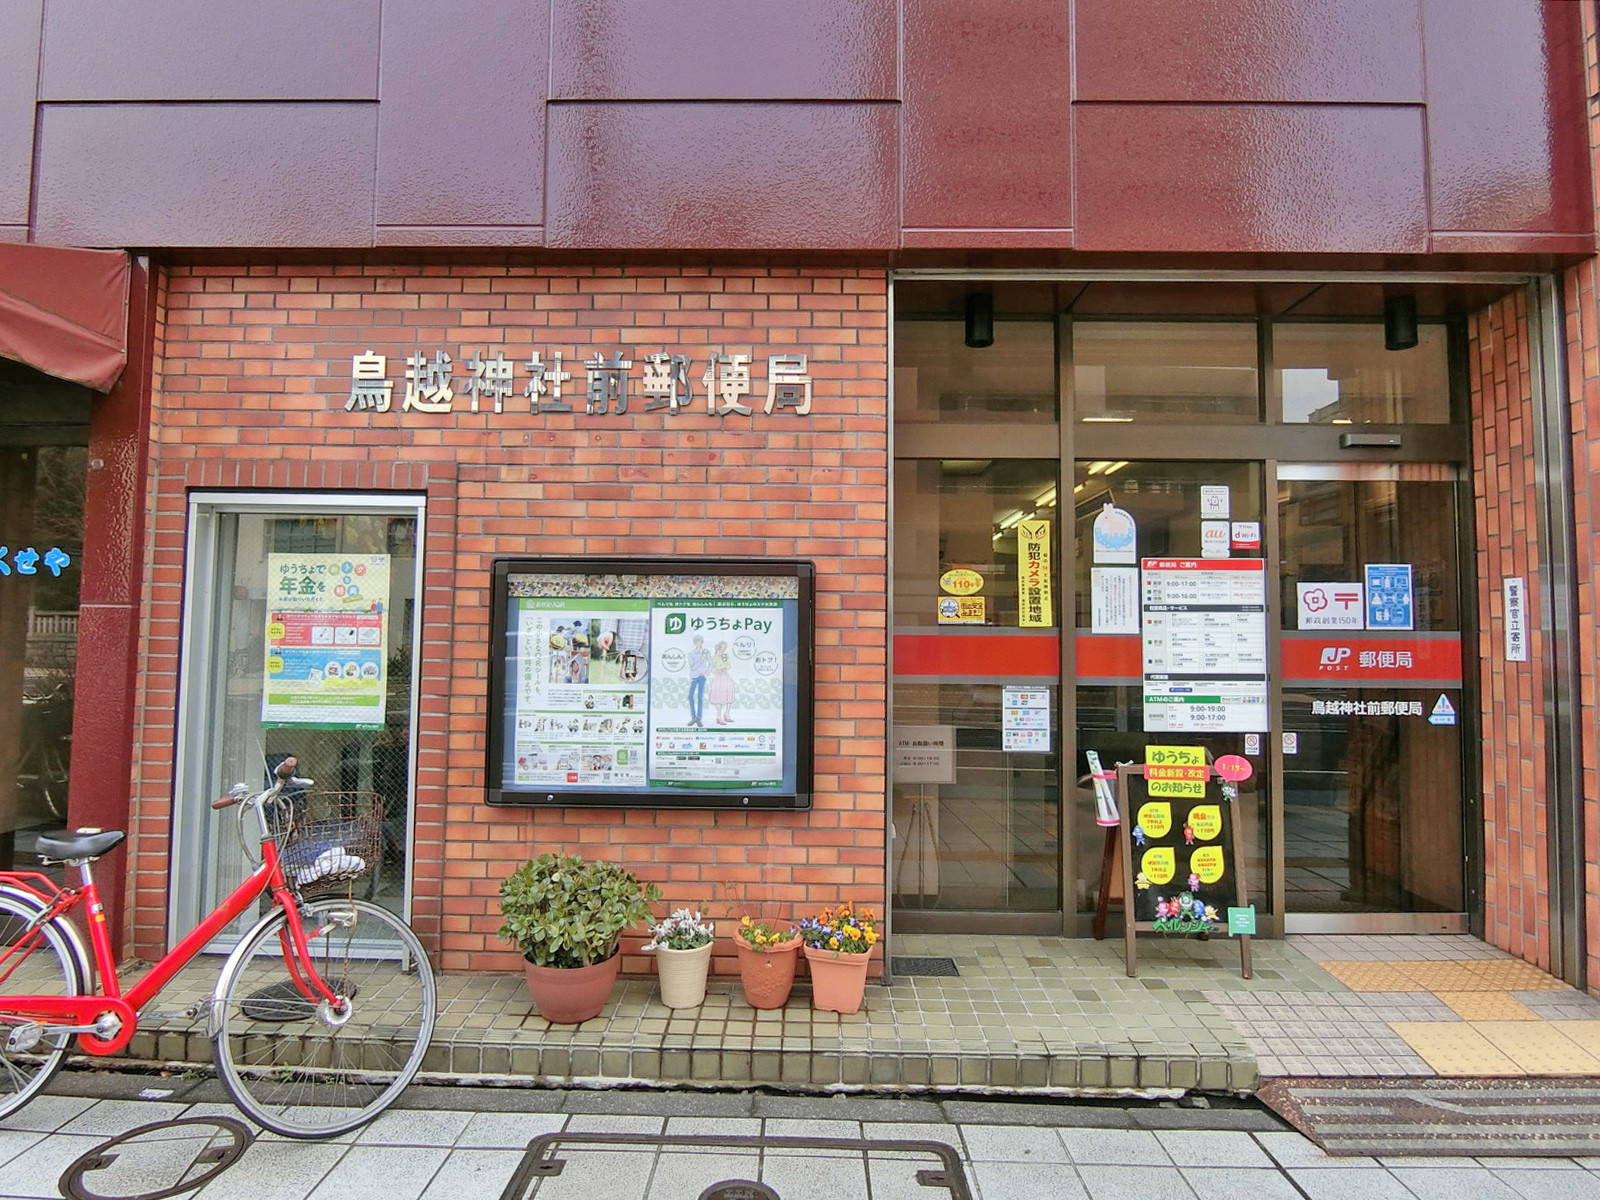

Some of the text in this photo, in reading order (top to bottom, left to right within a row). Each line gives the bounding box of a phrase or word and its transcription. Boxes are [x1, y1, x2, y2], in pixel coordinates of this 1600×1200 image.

[344, 350, 813, 416] 鳥越神社前郵便局
[280, 563, 327, 575] ゆうちょで
[279, 576, 326, 595] 年金を
[1028, 542, 1042, 623] 防犯カメラ設置地域
[690, 617, 772, 634] ゆうちょPay
[1305, 616, 1358, 625] 郵政創業150年
[1359, 651, 1413, 669] 郵便局
[1311, 700, 1423, 716] 鳥越神社前郵便局
[1152, 750, 1200, 765] ゆうちょ
[1148, 767, 1205, 779] 料金新設・改定
[1151, 781, 1203, 794] のお知らせ
